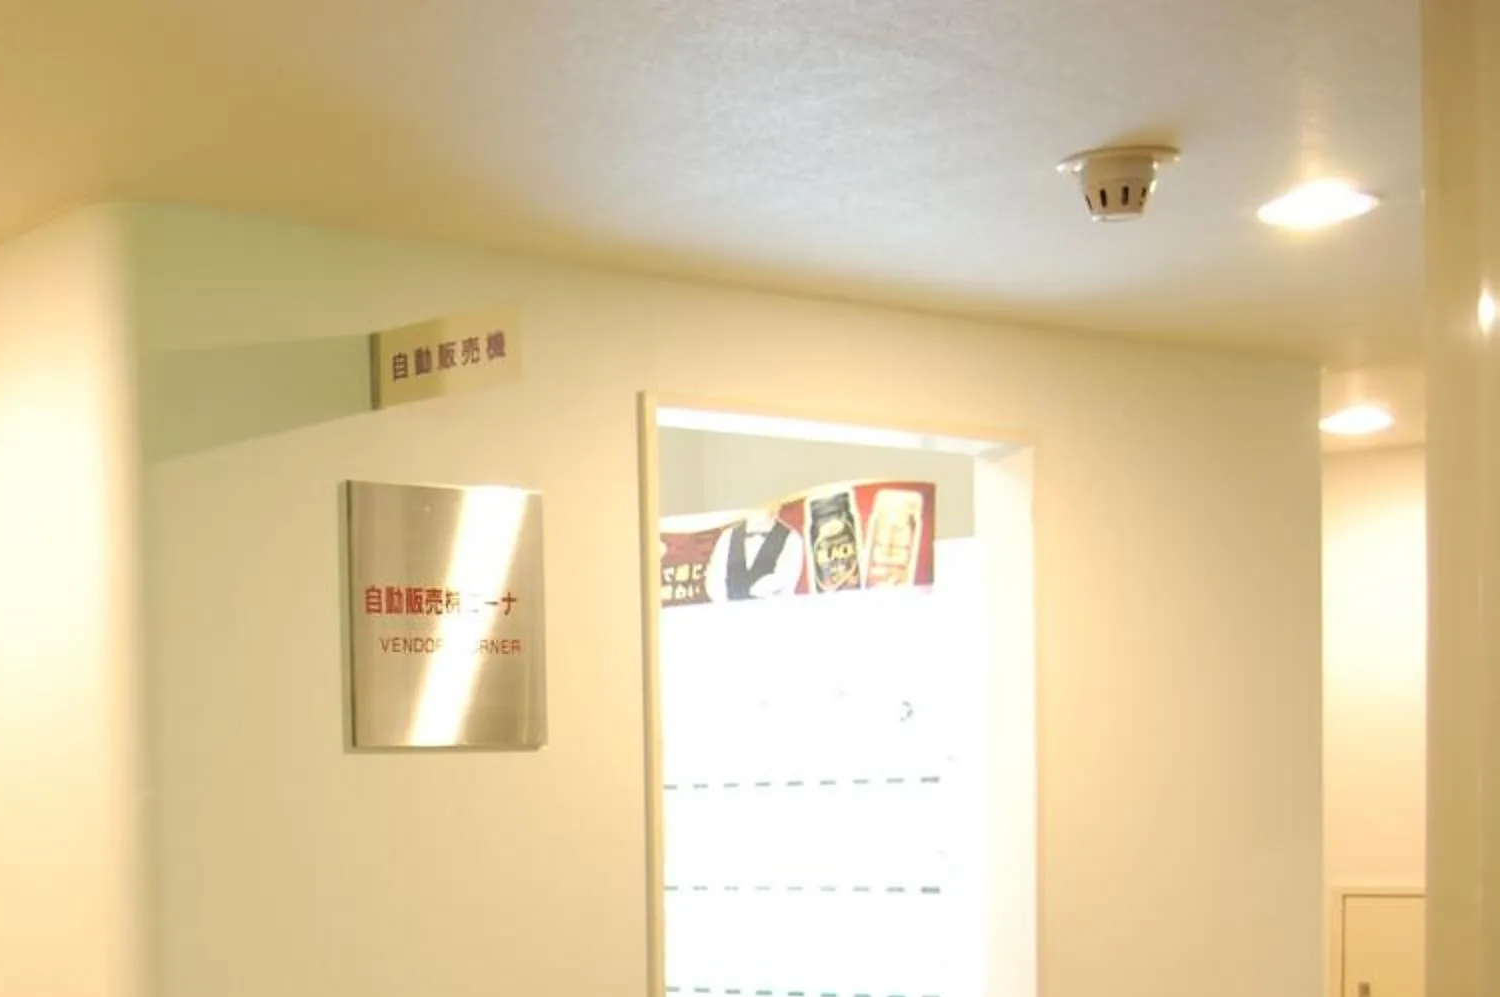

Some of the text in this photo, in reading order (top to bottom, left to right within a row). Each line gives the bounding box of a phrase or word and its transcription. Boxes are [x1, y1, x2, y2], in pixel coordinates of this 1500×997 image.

[391, 329, 506, 382] 自動販売機
